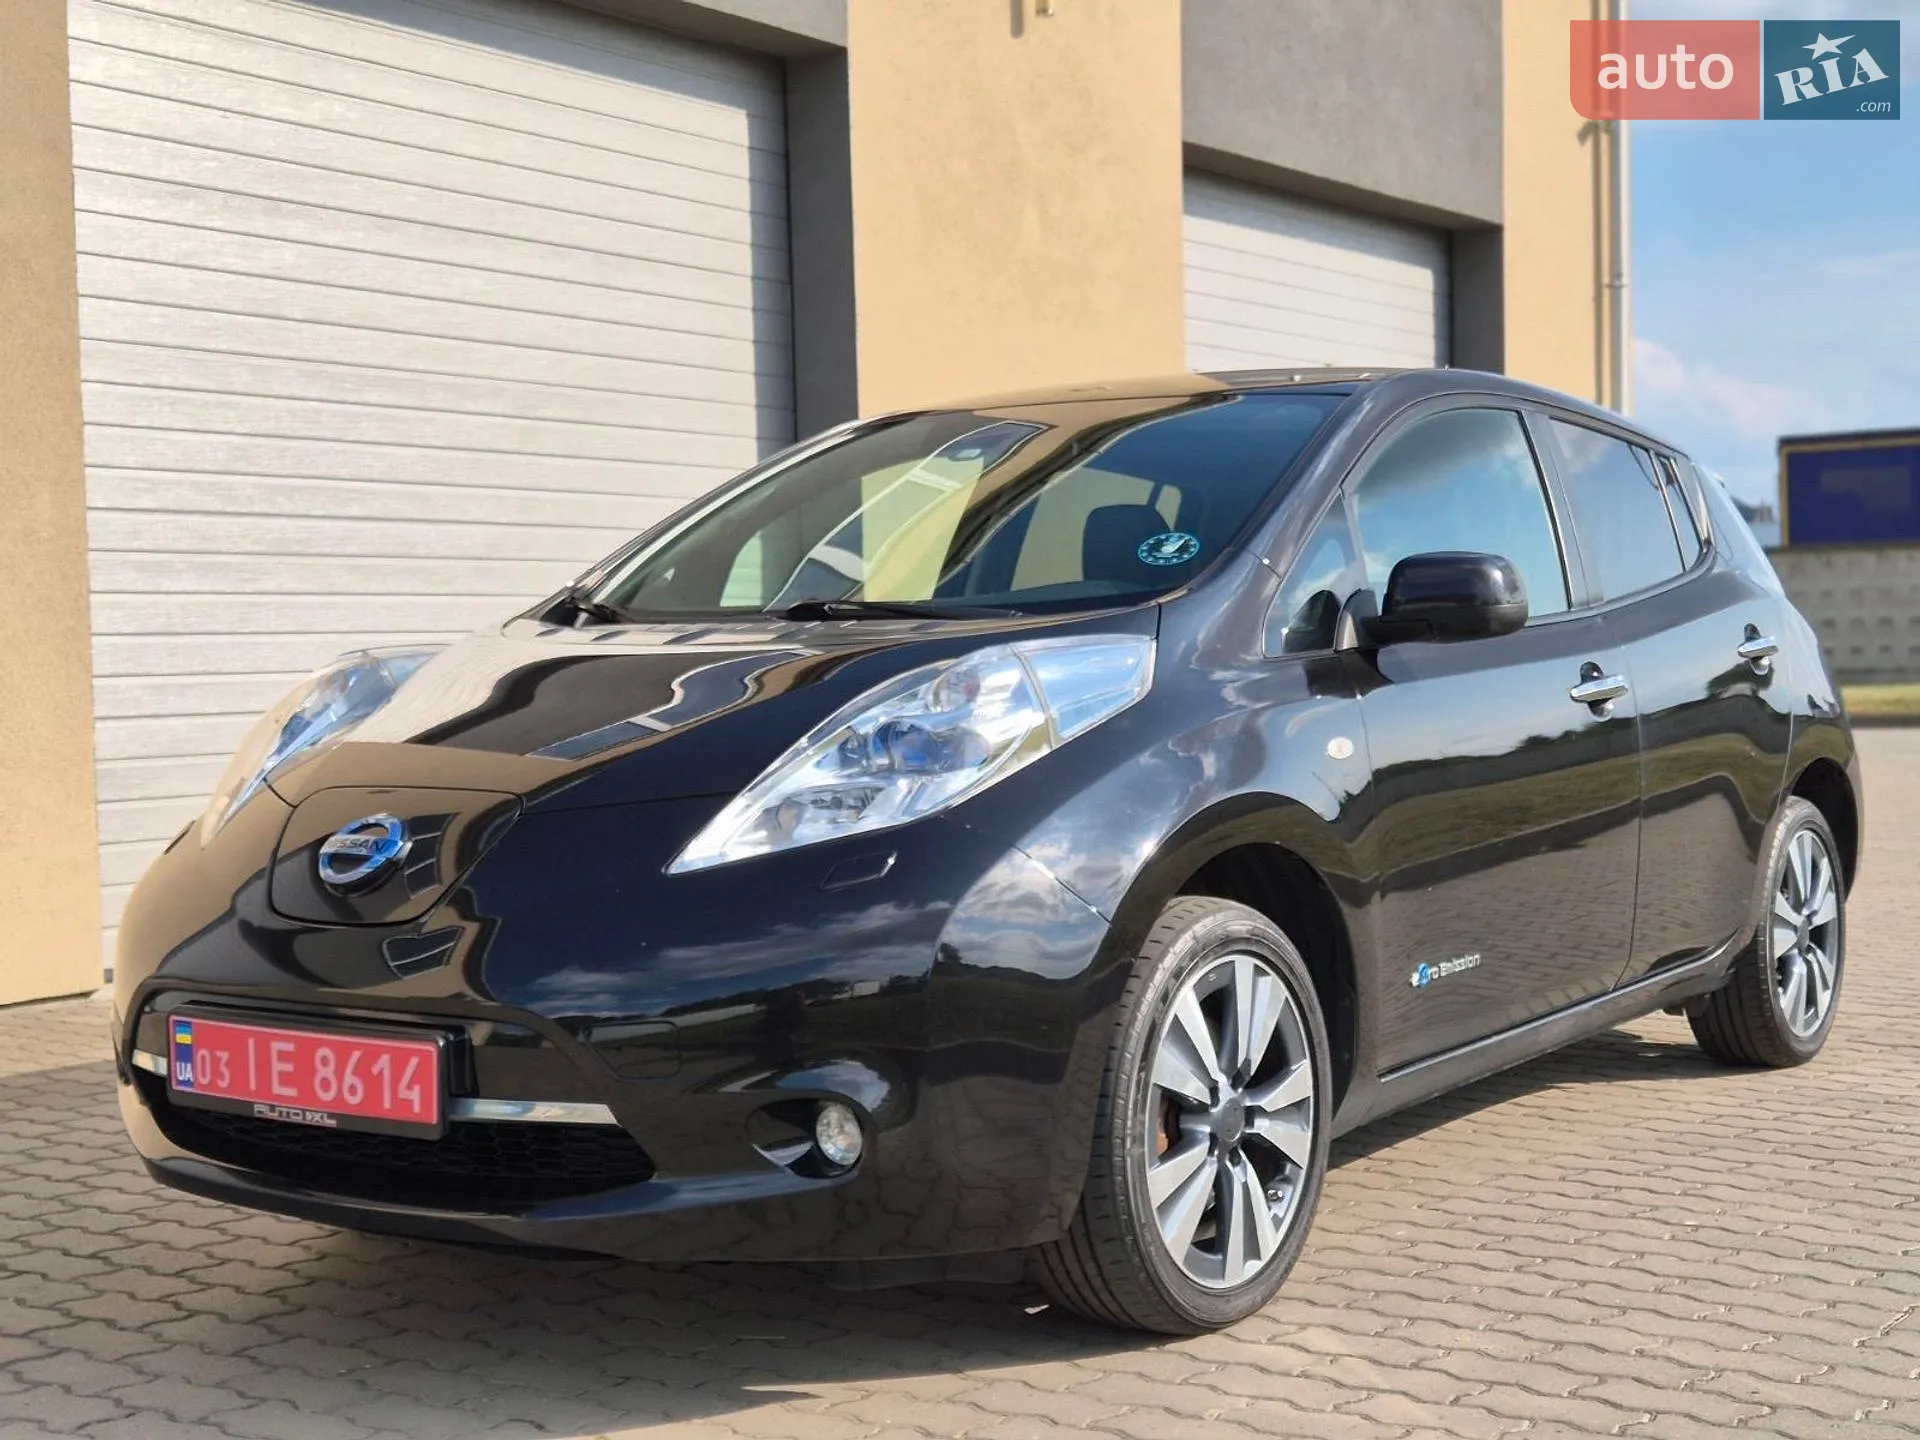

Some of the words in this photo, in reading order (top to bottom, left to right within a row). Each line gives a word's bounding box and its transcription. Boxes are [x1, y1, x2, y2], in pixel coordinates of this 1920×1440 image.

[176, 1061, 193, 1082] UA
[196, 1049, 231, 1088] 03
[313, 1045, 421, 1115] 8614
